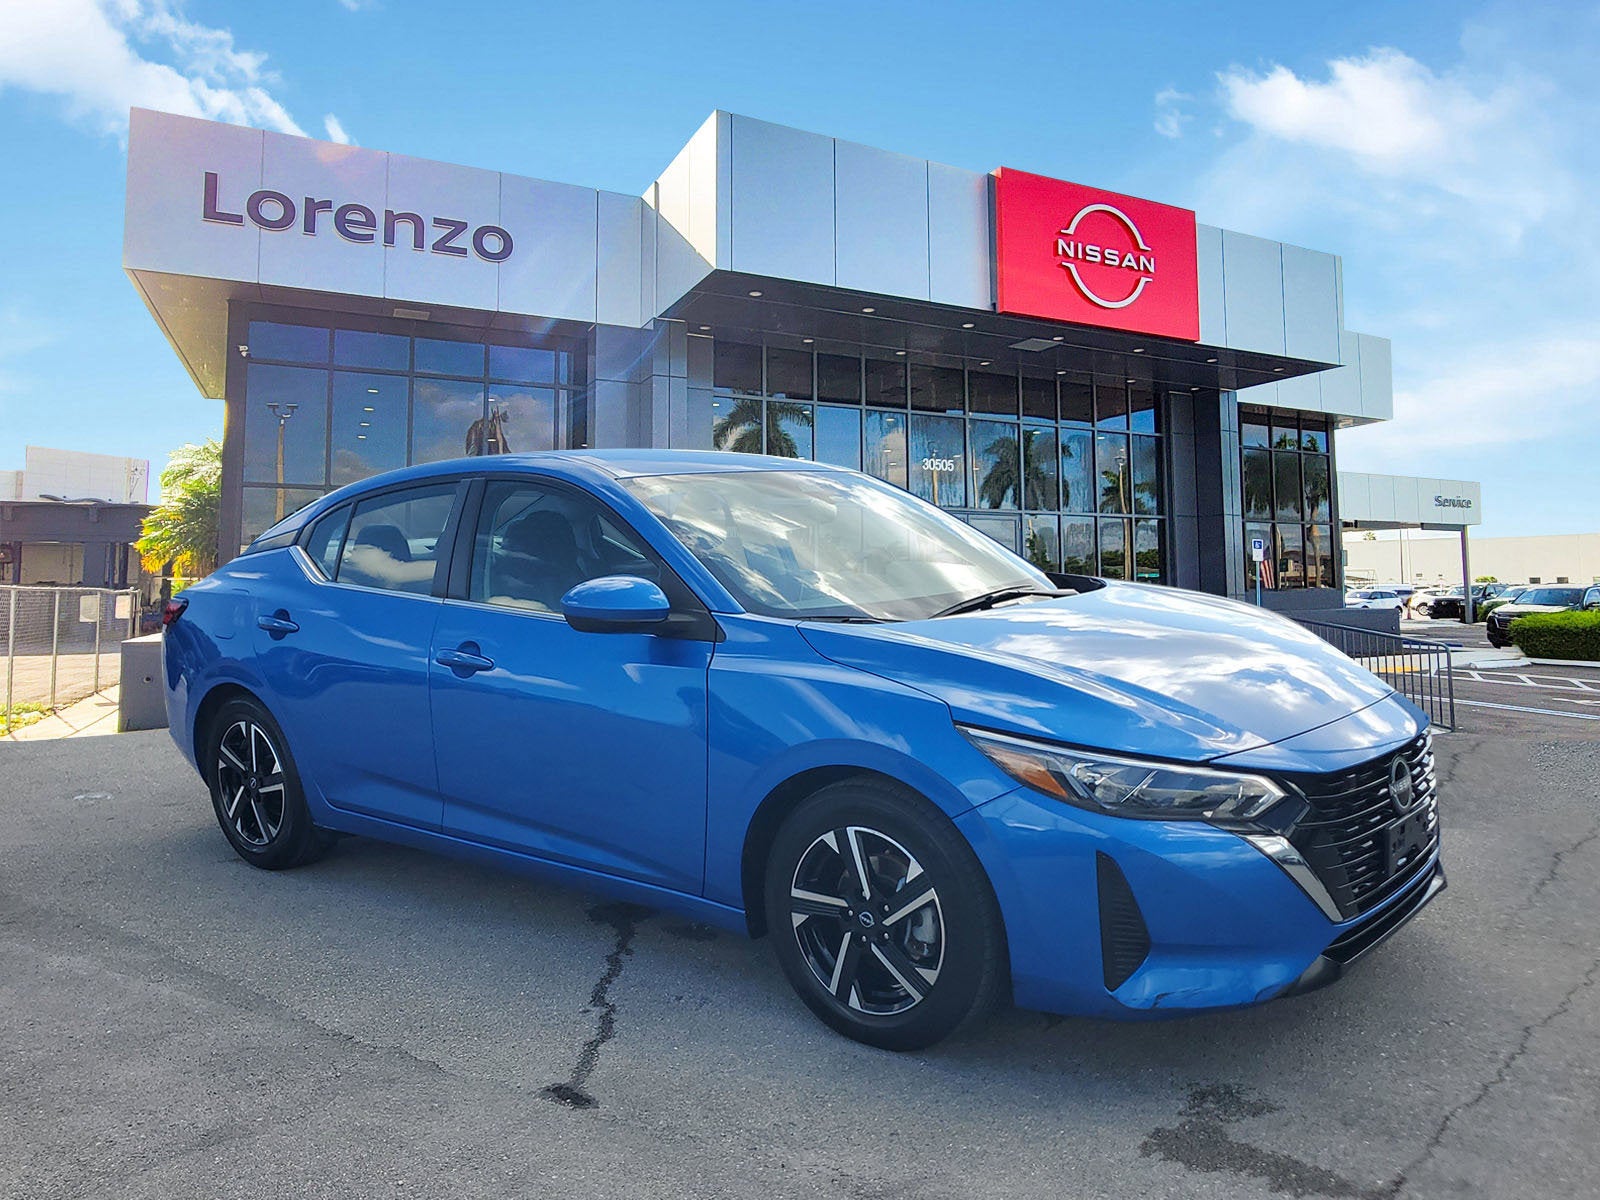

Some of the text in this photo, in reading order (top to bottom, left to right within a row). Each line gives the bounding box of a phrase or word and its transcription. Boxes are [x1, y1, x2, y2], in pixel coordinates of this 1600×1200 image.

[203, 171, 514, 262] Lorenzo
[1057, 238, 1155, 273] NISSAN
[922, 458, 954, 471] 30505
[1434, 495, 1472, 508] Service
